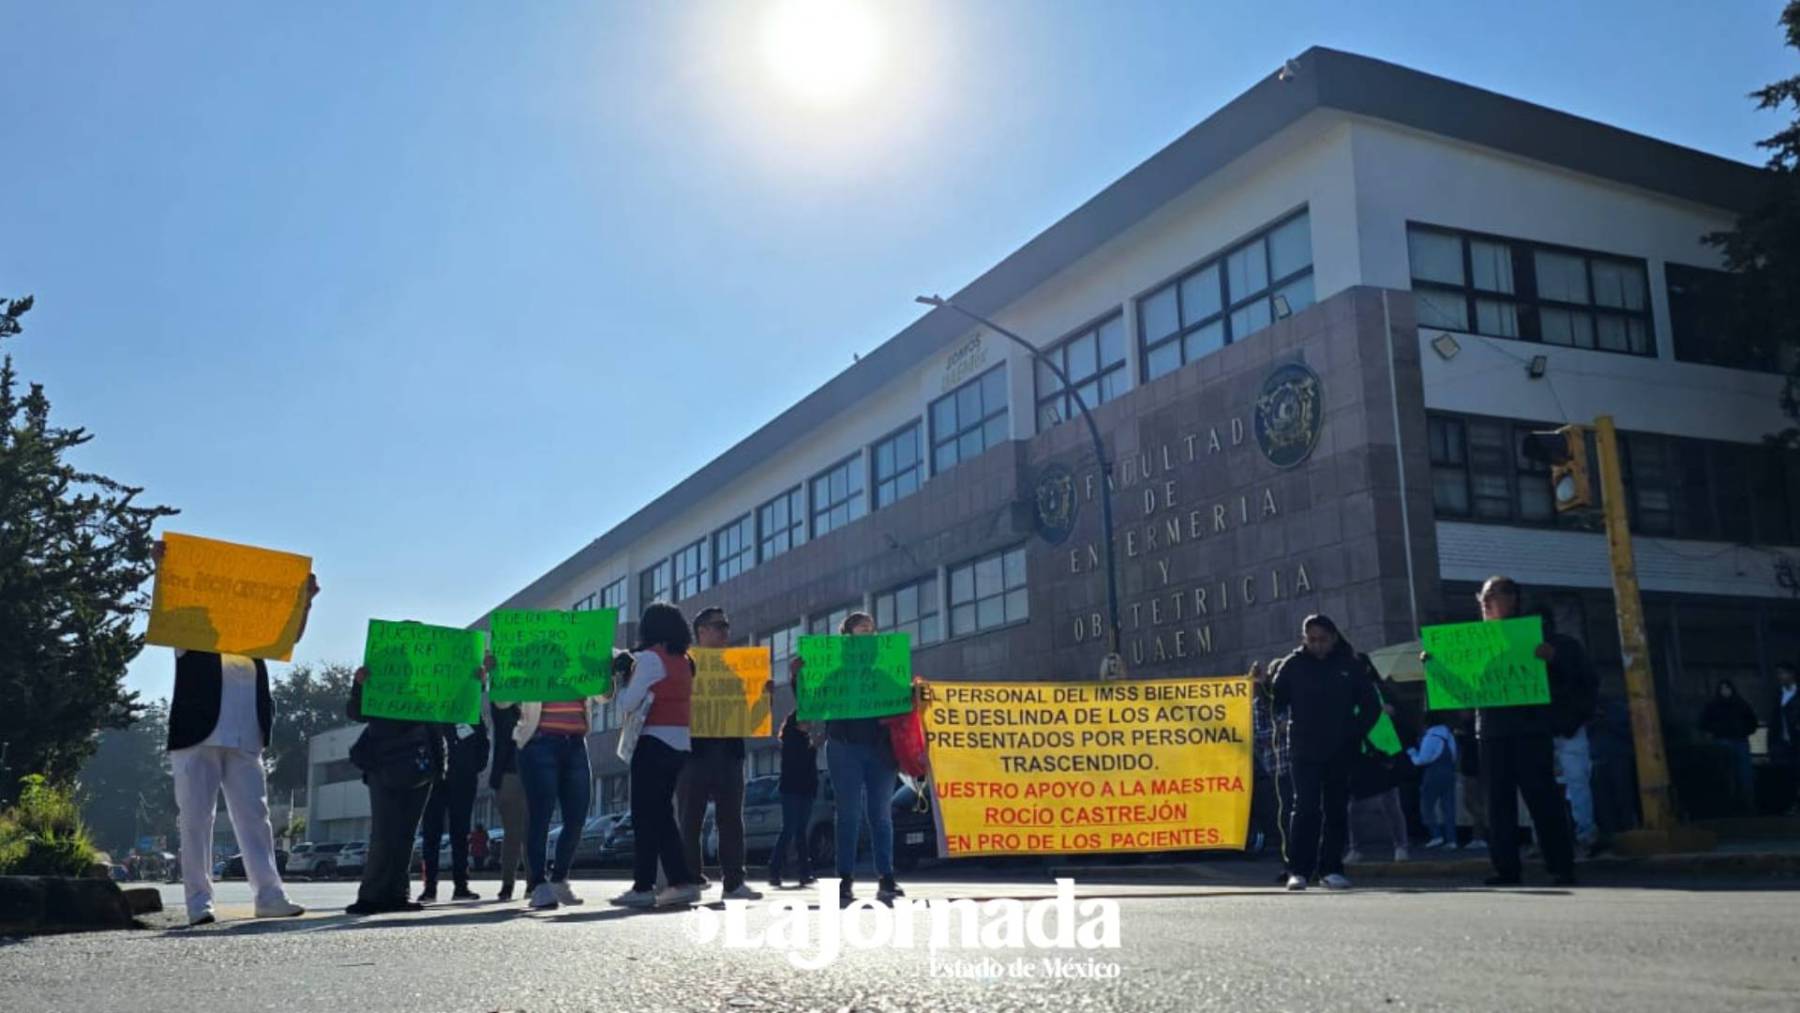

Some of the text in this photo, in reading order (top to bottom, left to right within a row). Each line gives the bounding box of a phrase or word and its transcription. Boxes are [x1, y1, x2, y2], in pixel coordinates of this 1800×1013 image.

[1145, 481, 1177, 514] DE
[1071, 488, 1278, 573] ENERMERIA
[1158, 559, 1171, 585] Y
[1074, 562, 1313, 642] OBTETRICIA
[946, 688, 1048, 704] PERSONAL
[1054, 687, 1089, 703] DEL
[1095, 685, 1138, 701] IMSS
[1145, 682, 1248, 701] BIENESTAR
[934, 704, 1226, 726] SE DESLINDA DE LOS ACTOS
[926, 726, 1243, 748] PRESENTADOS POR PERSONAL
[1000, 753, 1159, 773] TRASCENDIDO.
[936, 776, 1245, 799] UESTRO APOYO A LA MAESTRA
[985, 800, 1188, 826] ROCÍO CASTREJÓN
[946, 827, 1225, 852] EN PRO DE LOS PACIENTES.
